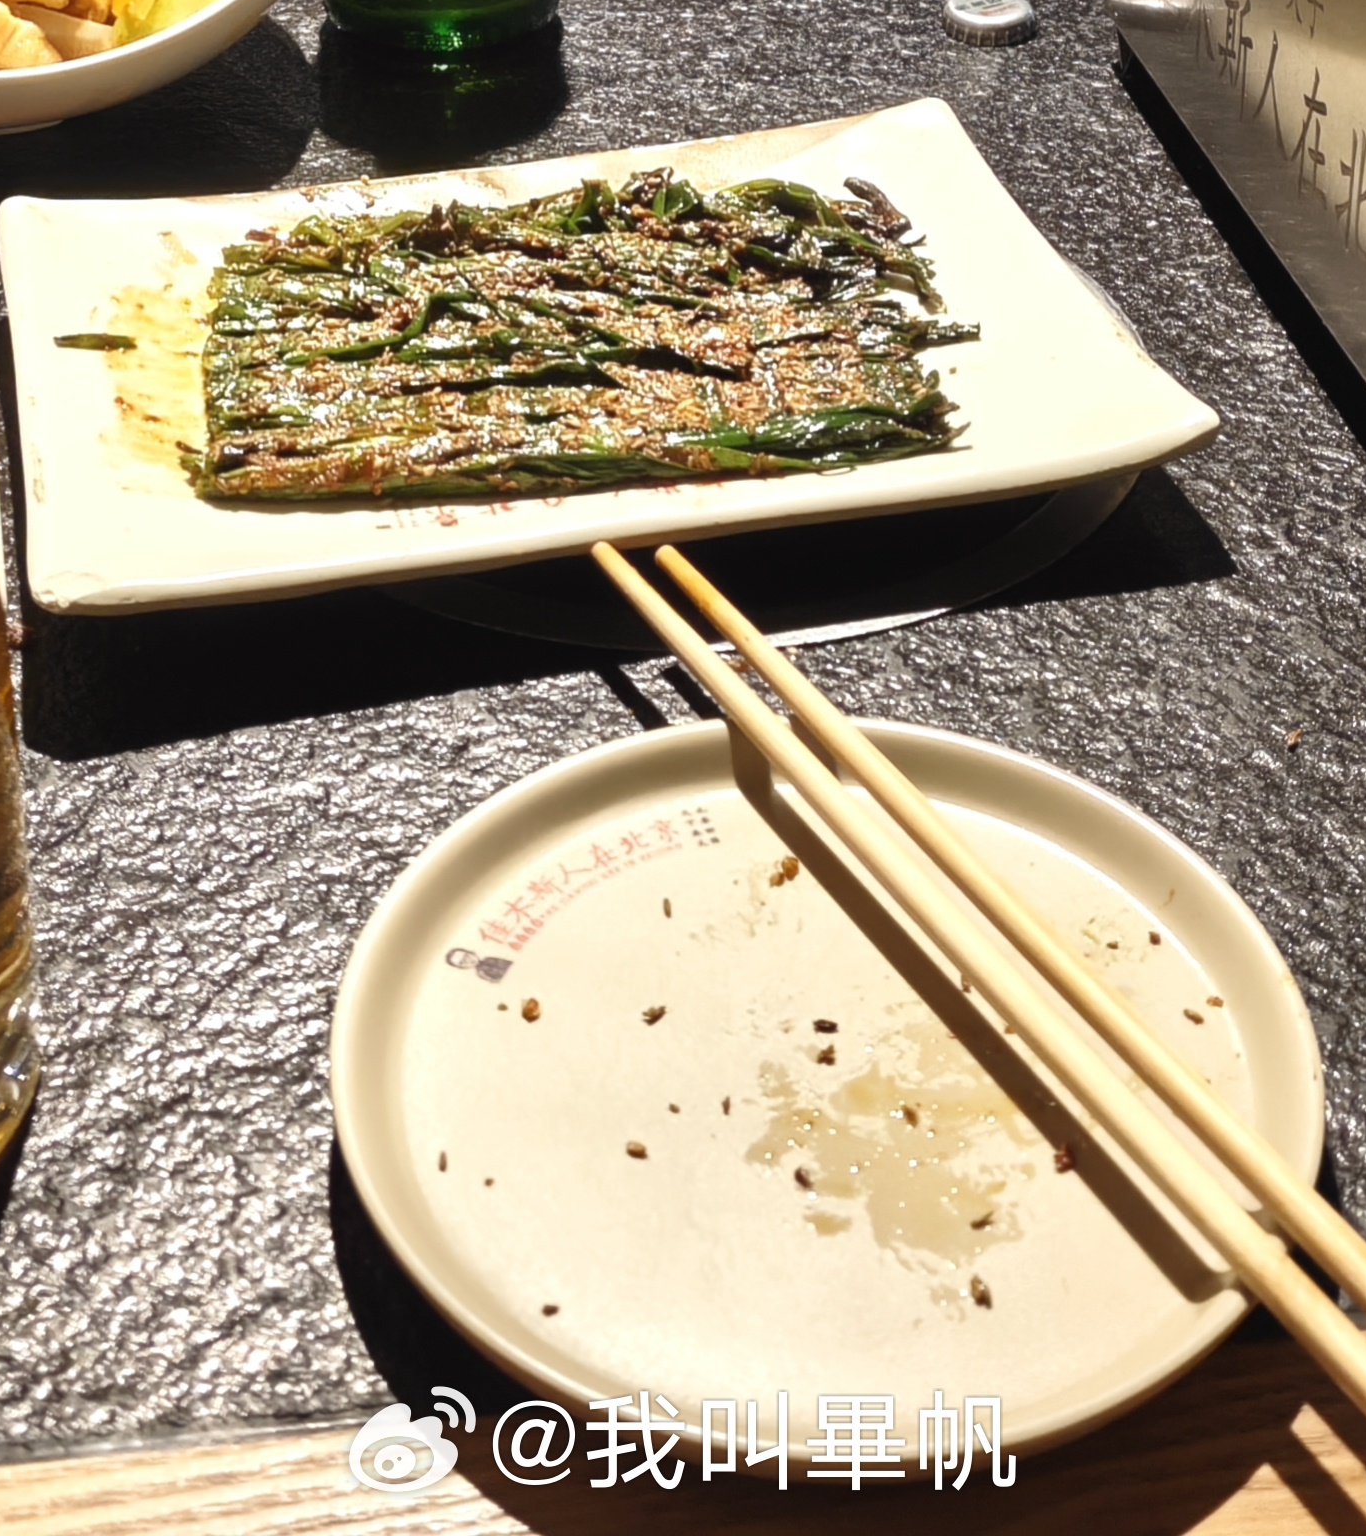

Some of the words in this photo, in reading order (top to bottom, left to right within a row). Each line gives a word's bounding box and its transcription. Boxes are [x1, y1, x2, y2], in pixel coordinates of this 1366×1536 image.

[478, 819, 680, 946] 佳木斯人在北京
